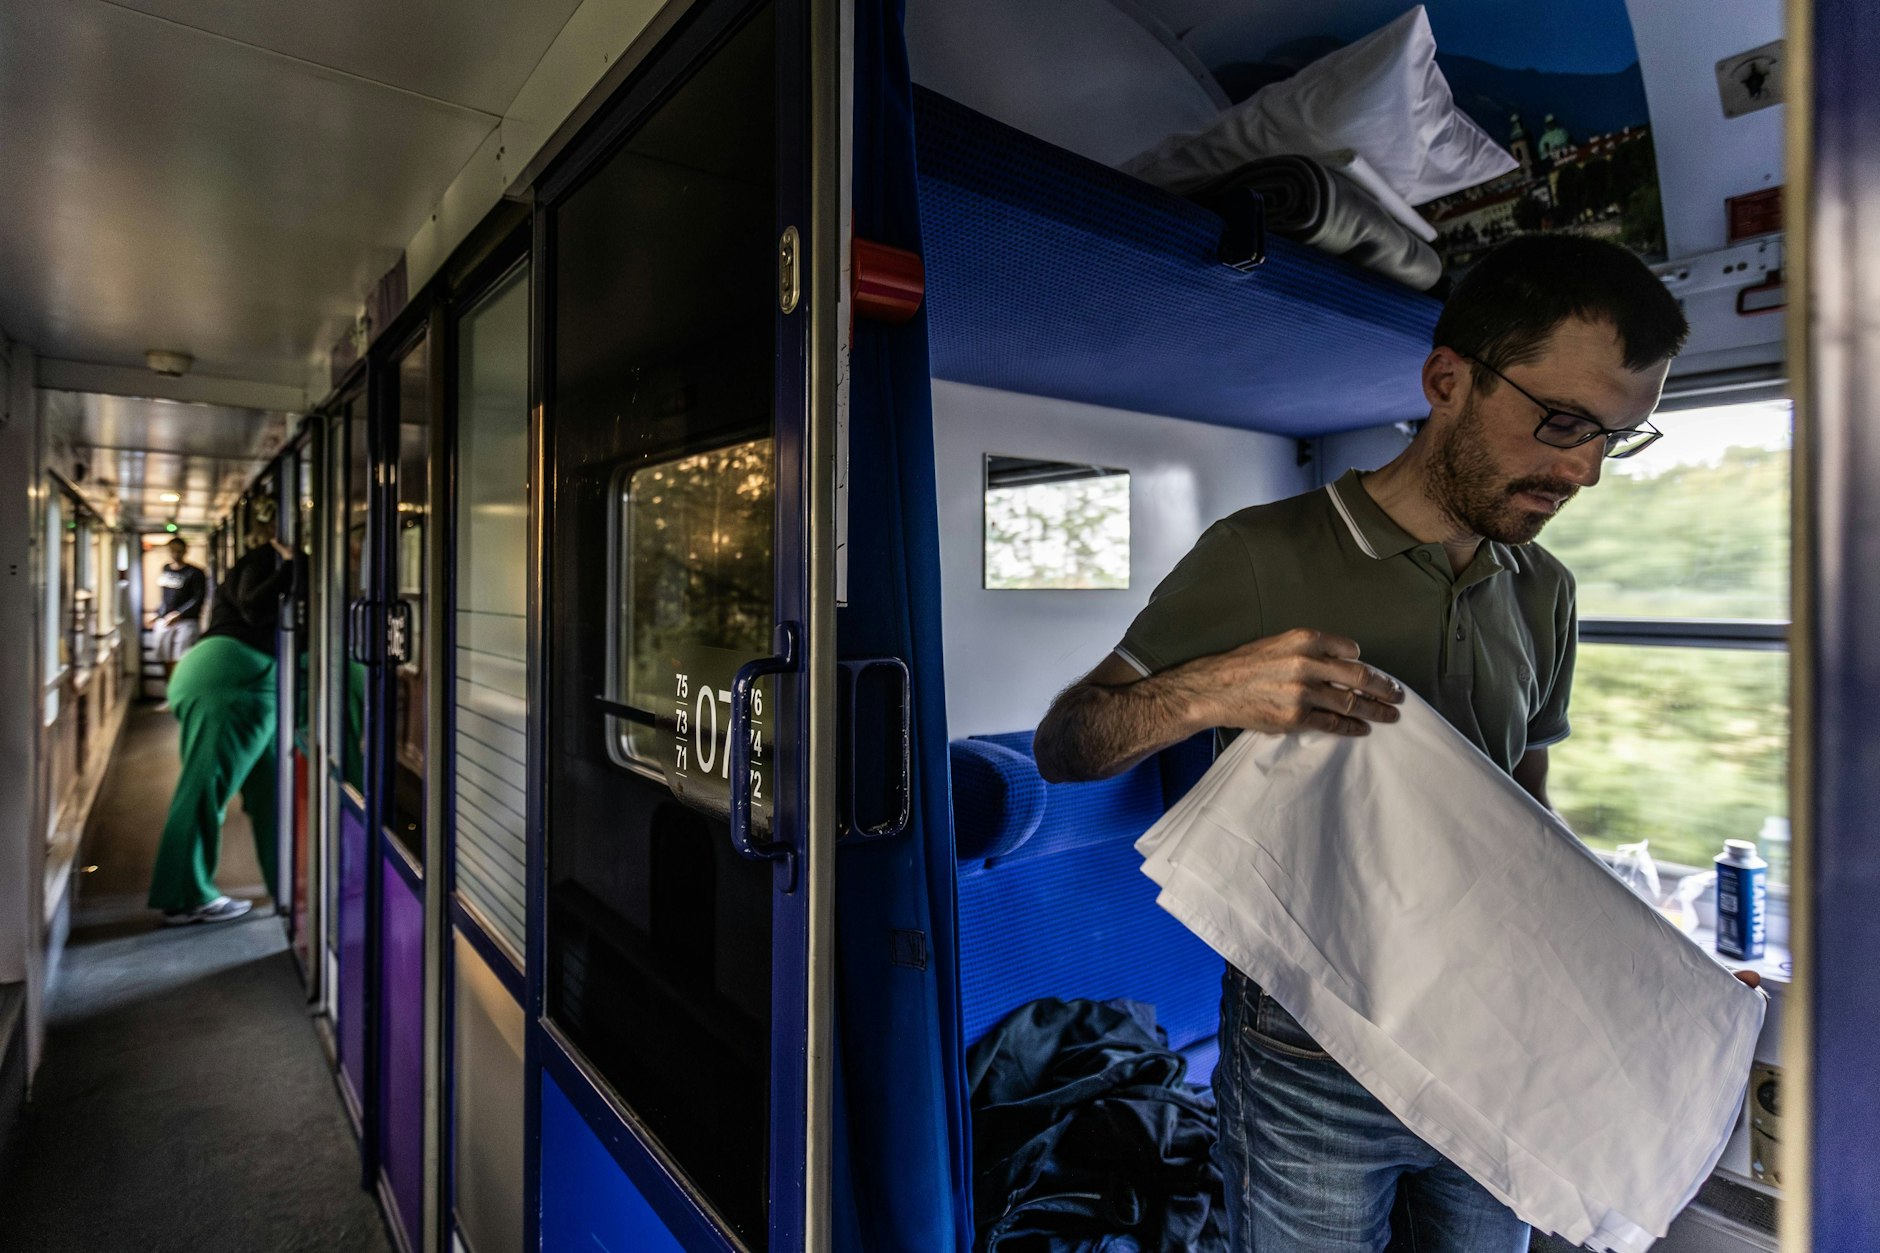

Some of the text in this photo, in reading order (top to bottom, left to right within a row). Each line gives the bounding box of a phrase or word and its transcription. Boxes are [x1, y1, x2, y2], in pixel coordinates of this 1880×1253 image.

[676, 673, 688, 698] 75
[676, 709, 687, 735] 73
[676, 745, 687, 770] 71
